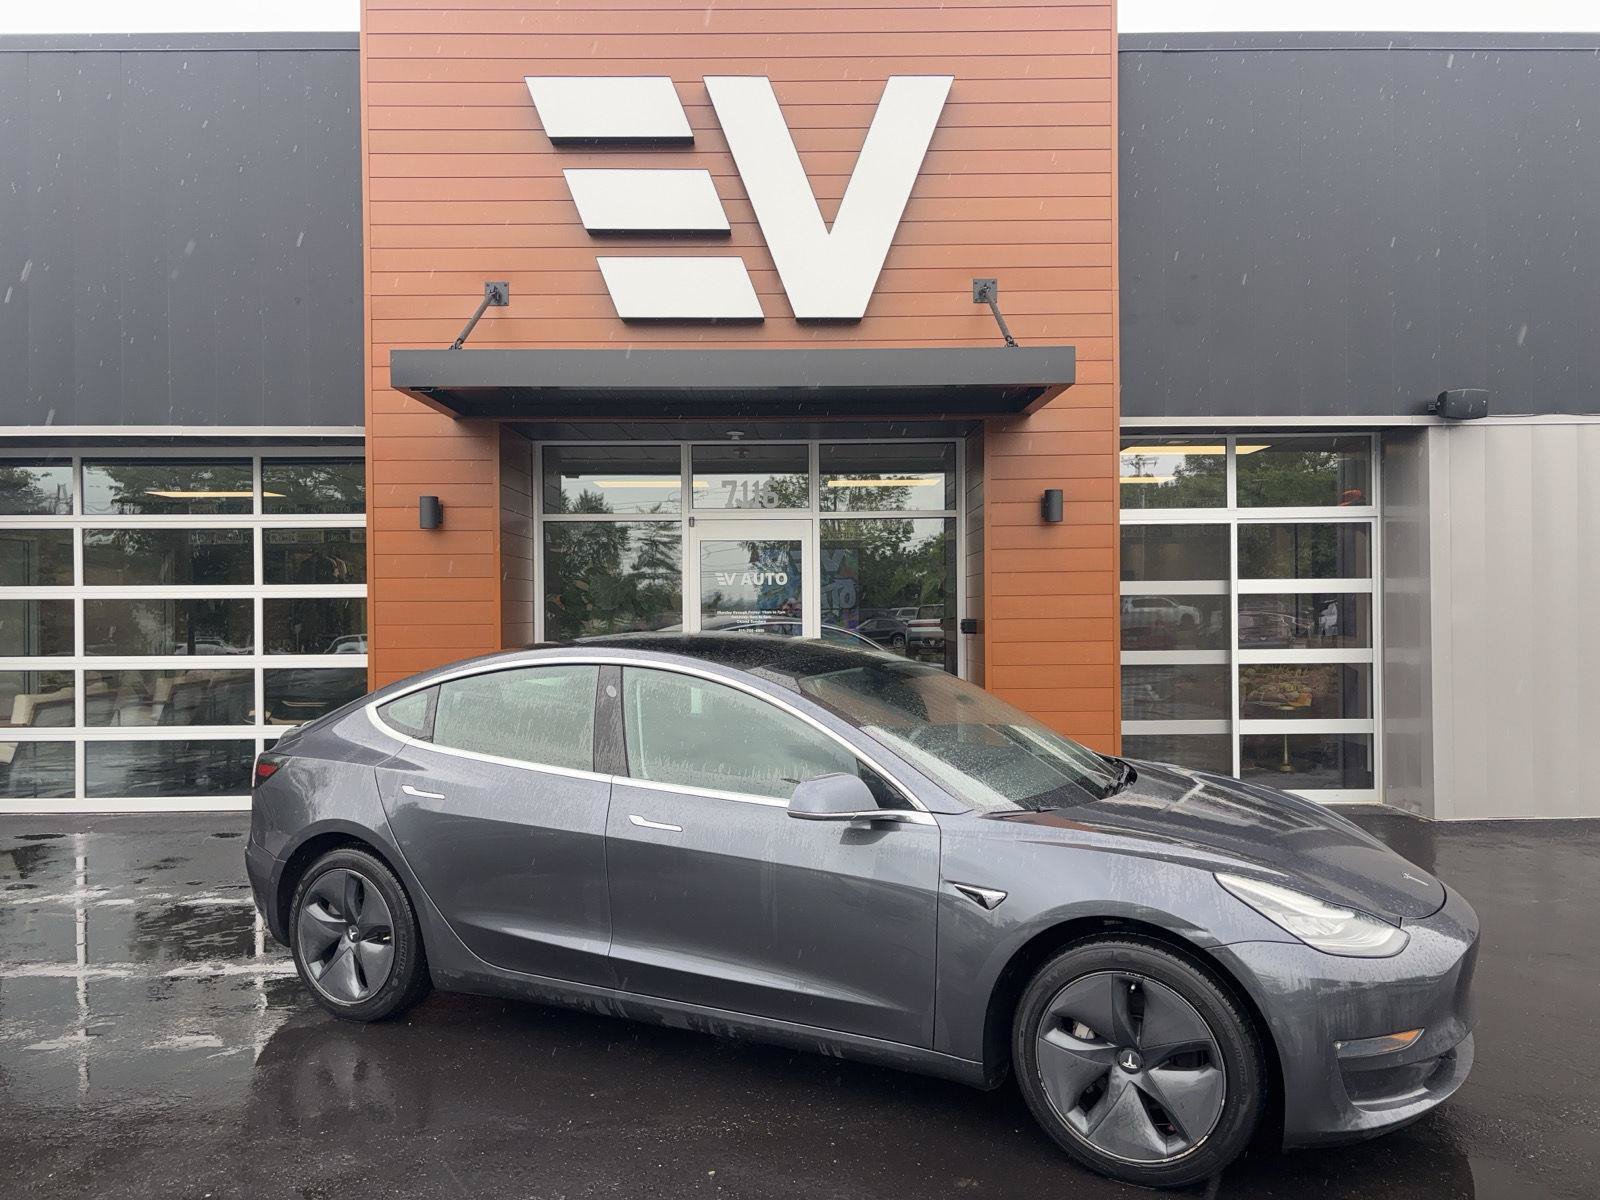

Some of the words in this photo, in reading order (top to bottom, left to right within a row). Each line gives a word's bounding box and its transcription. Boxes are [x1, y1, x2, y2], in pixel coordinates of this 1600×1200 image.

[524, 75, 955, 321] EV
[721, 479, 779, 508] 7116
[714, 572, 737, 586] EV
[740, 572, 788, 586] AUTO
